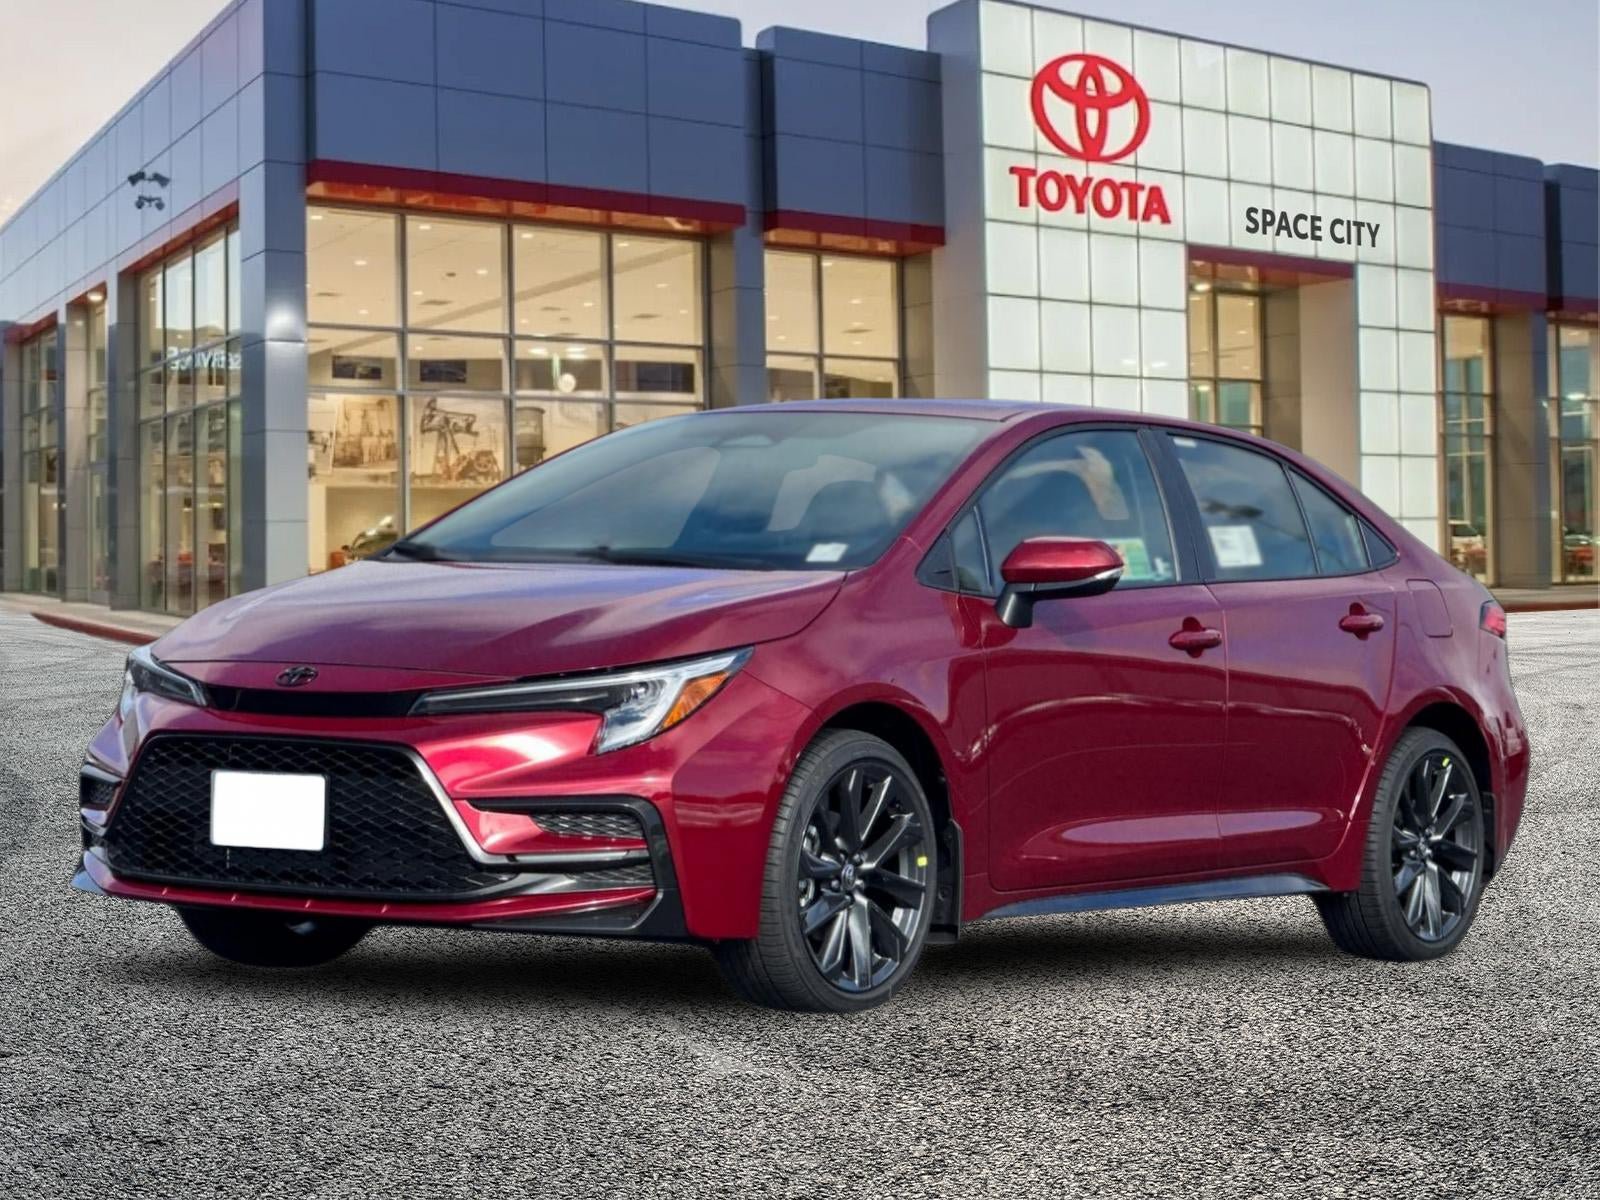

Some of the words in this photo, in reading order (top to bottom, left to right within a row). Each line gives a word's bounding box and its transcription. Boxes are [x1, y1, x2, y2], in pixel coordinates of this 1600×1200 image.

[1010, 166, 1171, 224] TOYOTA
[1245, 206, 1322, 242] SPACE
[1329, 218, 1380, 249] CITY
